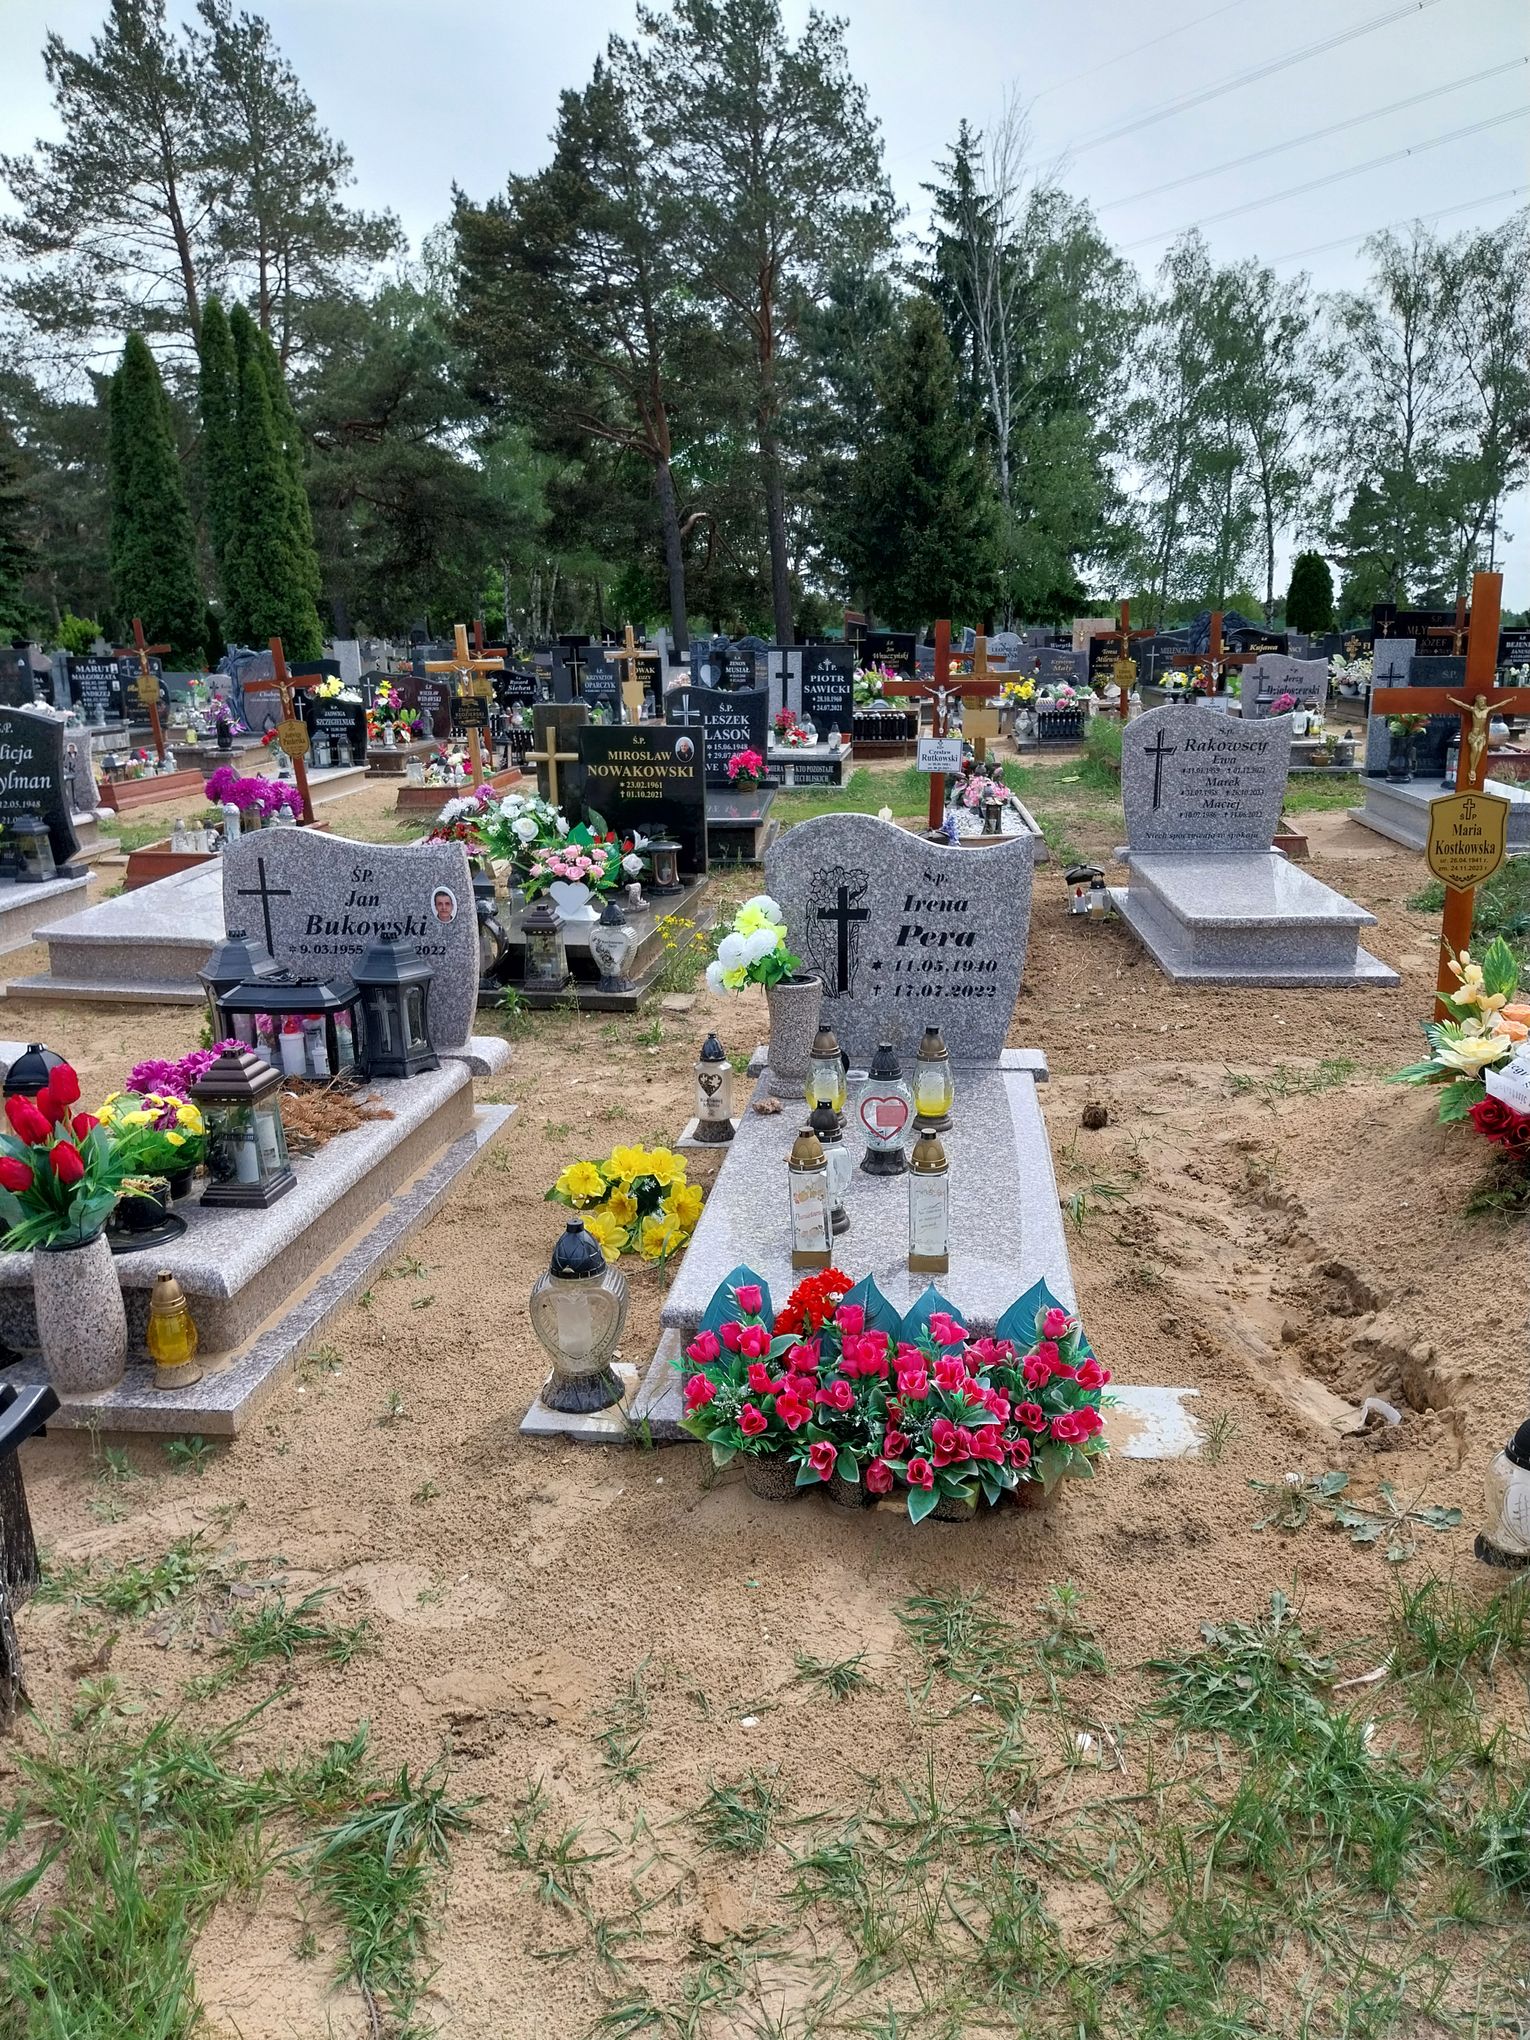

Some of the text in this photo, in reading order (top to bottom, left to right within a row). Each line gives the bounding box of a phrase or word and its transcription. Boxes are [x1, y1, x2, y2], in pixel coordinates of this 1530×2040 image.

[803, 685, 850, 694] SAWICKI
[719, 702, 734, 712] Ś.P.
[704, 715, 750, 725] LESZEK
[704, 726, 751, 740] LASOŃ
[1183, 738, 1269, 756] Rakowscy
[0, 743, 34, 765] licja
[608, 751, 672, 761] MIROSŁAW
[921, 754, 958, 762] Rutkowski
[1212, 755, 1237, 765] Ewa
[587, 764, 695, 778] NOWAKOWSKI
[0, 770, 52, 795] ylman
[626, 781, 663, 789] 23.02.1961
[1205, 777, 1240, 787] Marek
[626, 790, 663, 798] 01.10.2021
[1202, 799, 1241, 811] Maciej
[1452, 824, 1482, 836] Maria
[1435, 840, 1496, 855] Kostkowska
[344, 890, 380, 908] Jan
[903, 895, 969, 912] Irena
[305, 914, 428, 937] Bukowski
[896, 925, 976, 947] Pera
[893, 960, 998, 973] 11.05.1940
[893, 985, 997, 998] 17.07.2022
